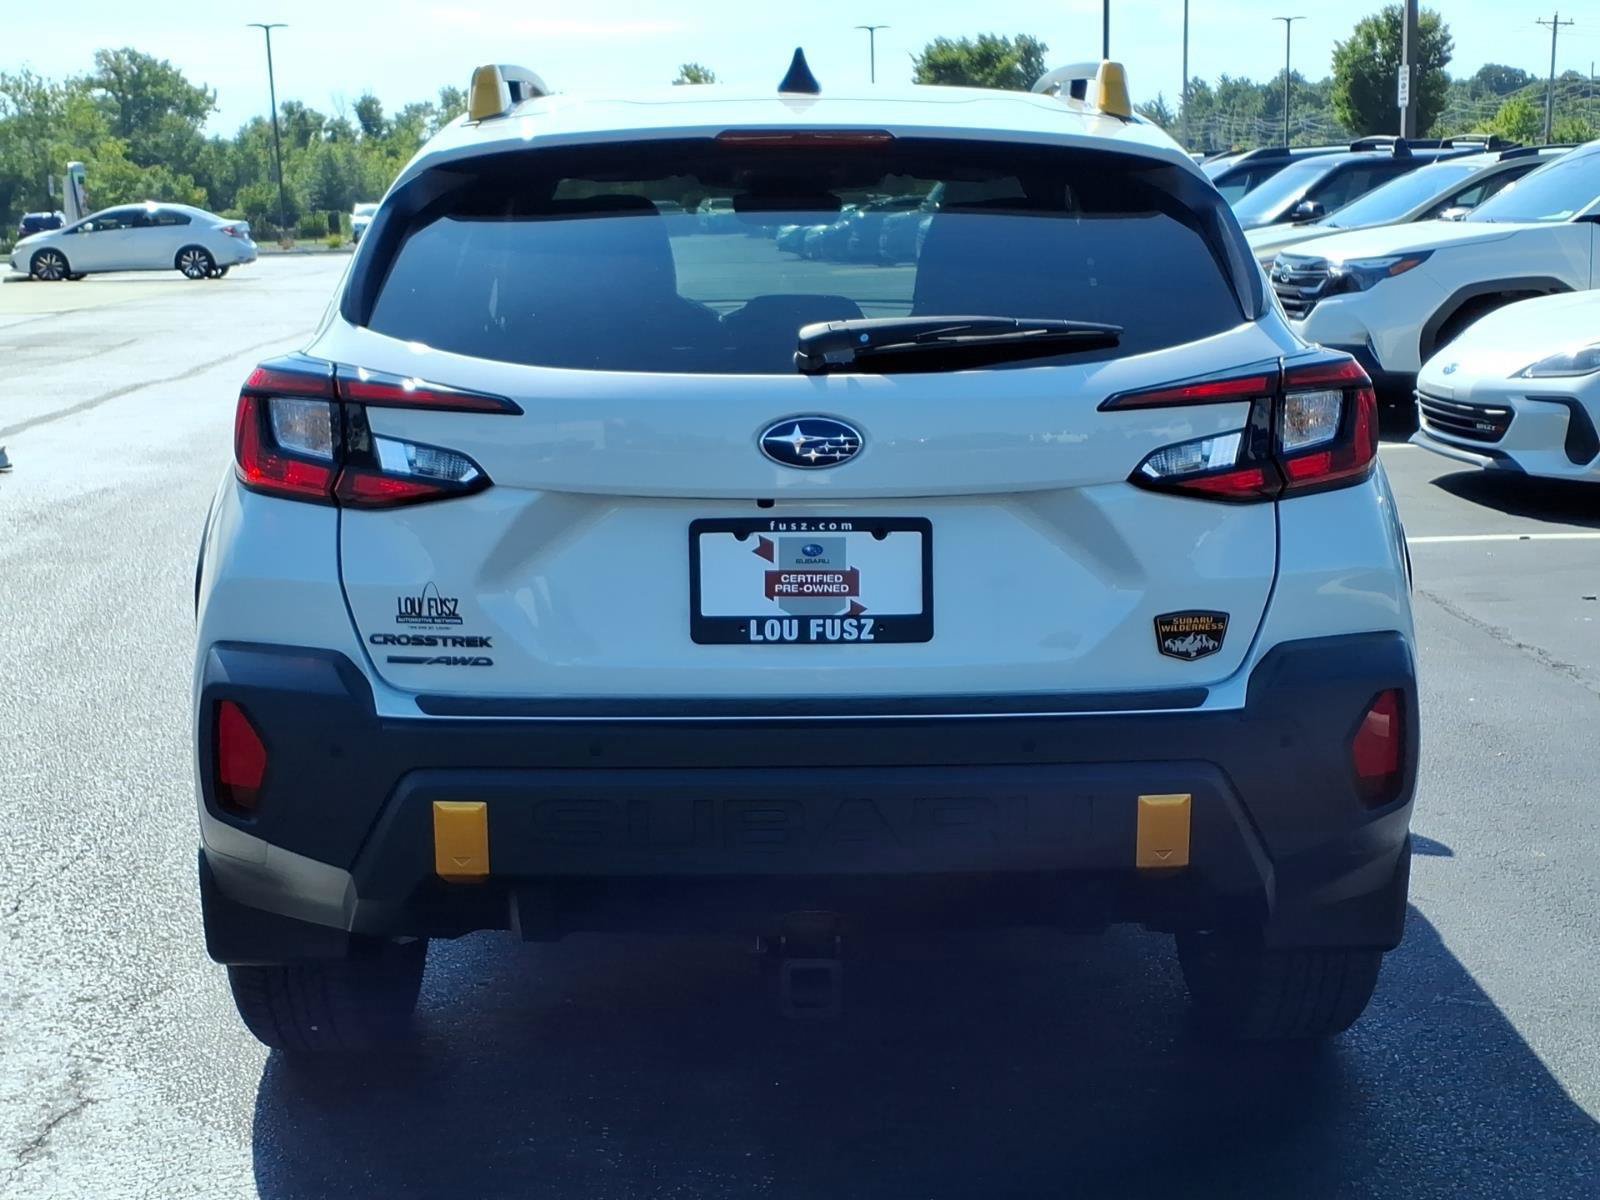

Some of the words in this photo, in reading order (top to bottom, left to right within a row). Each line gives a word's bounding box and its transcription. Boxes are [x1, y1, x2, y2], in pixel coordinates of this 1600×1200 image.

[769, 520, 853, 531] fusz.com
[780, 574, 843, 583] CERTIFIED
[774, 584, 850, 593] PRE-OWNED
[397, 597, 422, 616] LOU
[427, 597, 460, 617] FUSZ
[1173, 616, 1213, 625] SUBARU
[750, 619, 799, 641] LOU
[809, 618, 875, 641] FUSZ
[1161, 623, 1224, 633] WILDERNESS
[369, 633, 494, 648] CROSSTREK
[426, 655, 494, 667] AWD
